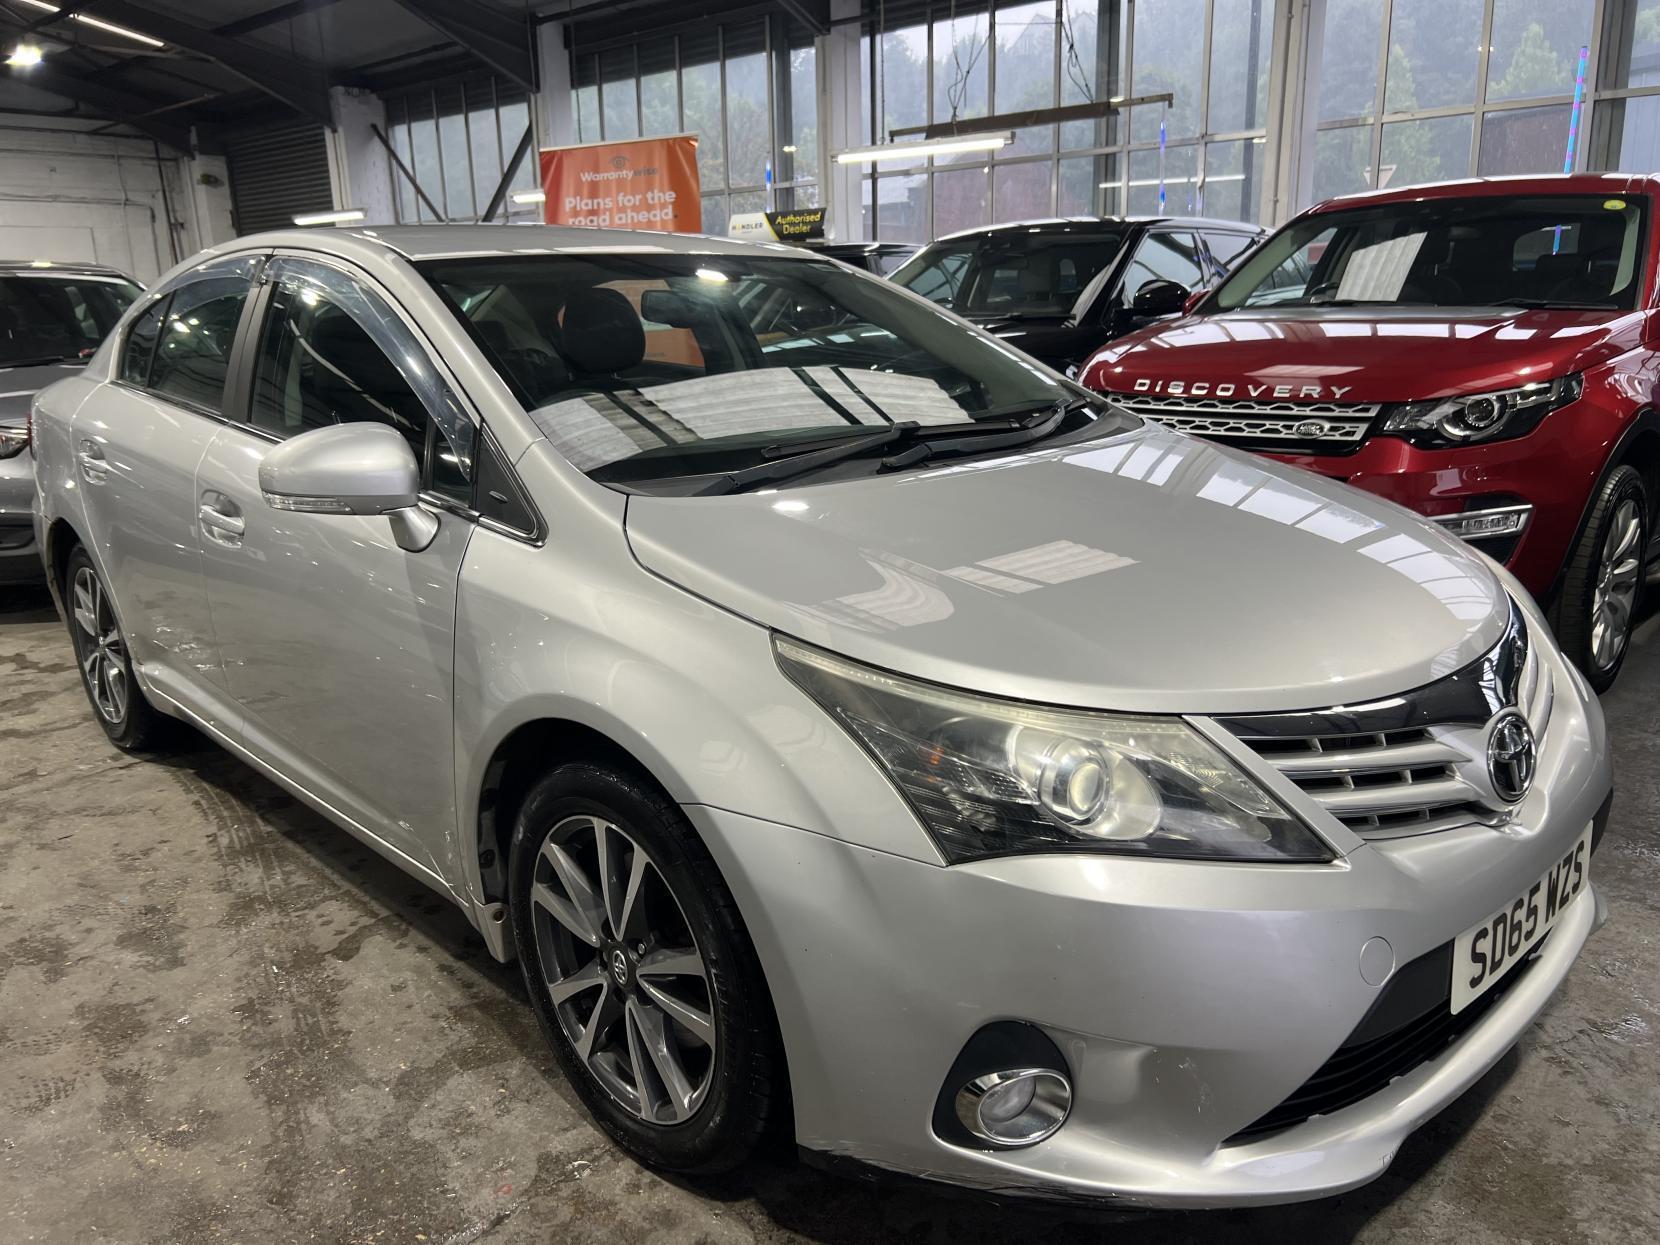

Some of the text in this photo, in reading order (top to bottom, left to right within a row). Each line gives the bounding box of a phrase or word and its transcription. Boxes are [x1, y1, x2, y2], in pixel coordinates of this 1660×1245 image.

[564, 188, 677, 212] Plans for the
[568, 204, 678, 227] road ahead.
[776, 210, 822, 225] Authorised
[783, 222, 812, 235] Dealer
[1133, 378, 1352, 399] DISCOVERY
[1468, 839, 1585, 989] SD65 WZS
